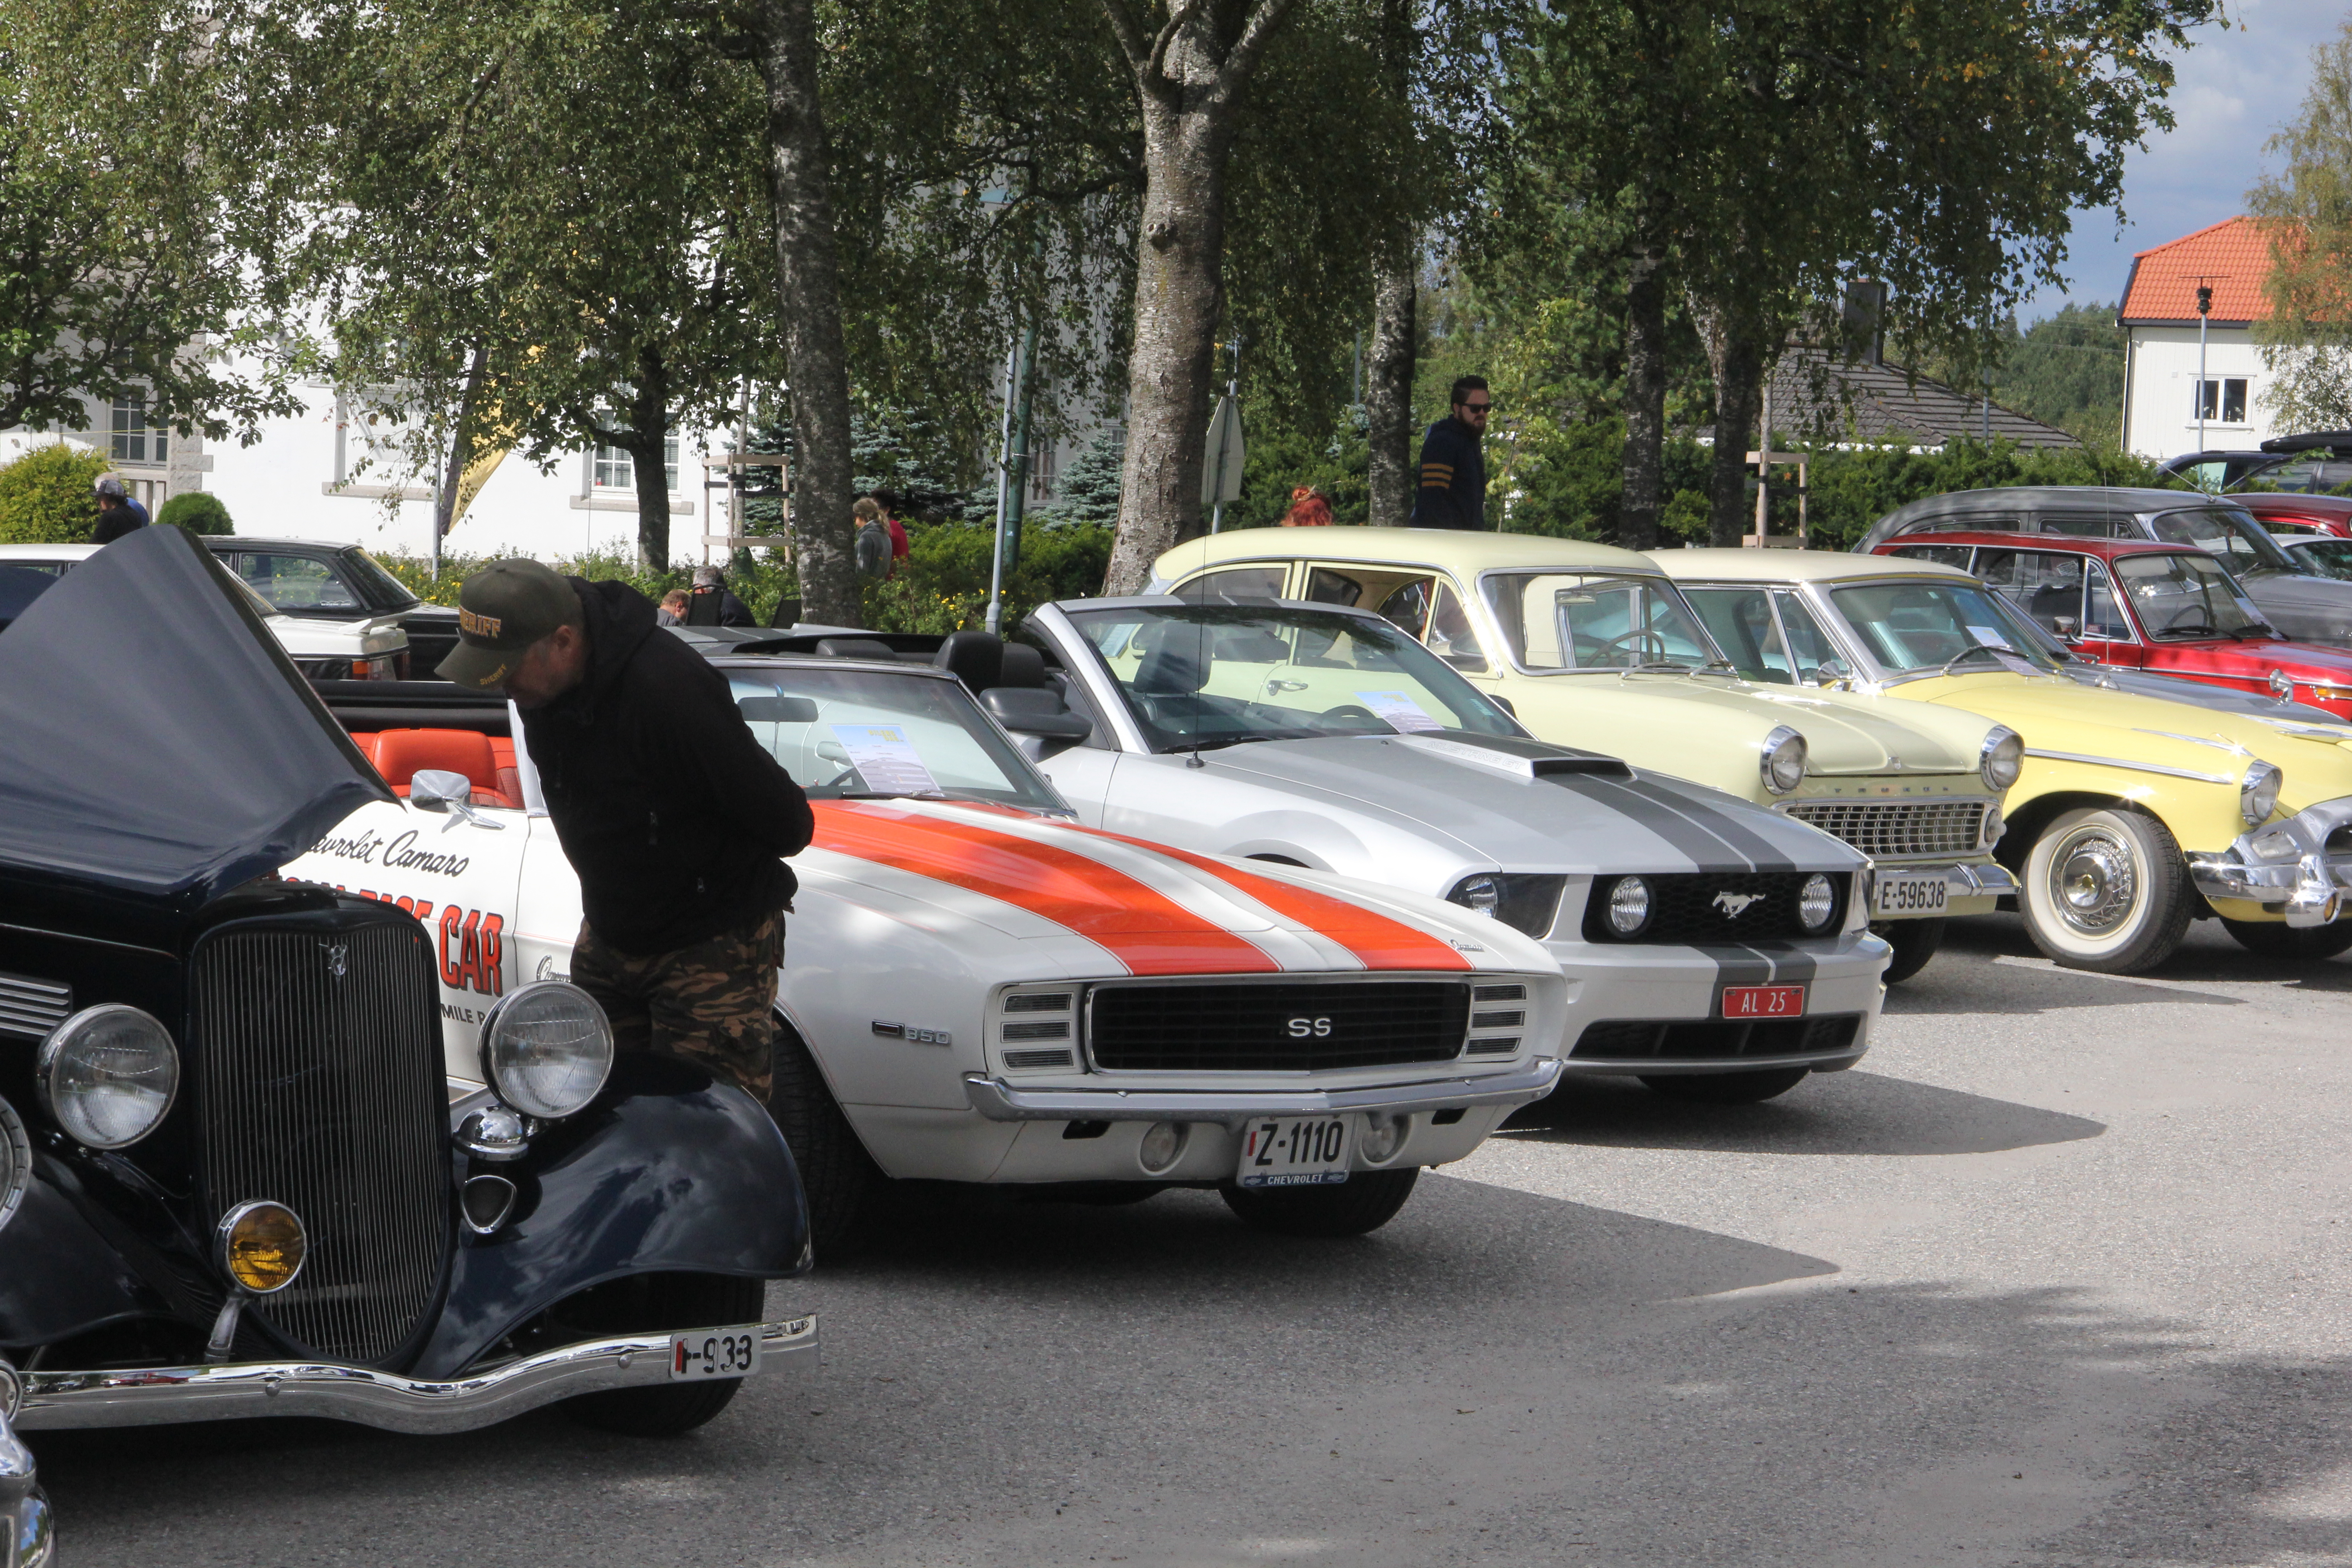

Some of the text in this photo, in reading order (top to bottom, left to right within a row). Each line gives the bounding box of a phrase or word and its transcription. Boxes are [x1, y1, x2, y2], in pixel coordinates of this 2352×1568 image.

[459, 604, 501, 638] ERIFF
[480, 664, 507, 685] SHERIFF
[1427, 741, 1525, 770] MUSTANG GT
[308, 829, 469, 877] evrolet Camaro
[1881, 881, 1945, 910] E-59638
[439, 904, 504, 997] CAR
[440, 1003, 474, 1024] MILE
[1741, 992, 1786, 1013] AL 25
[906, 1026, 951, 1044] 350
[1288, 1018, 1331, 1037] SS
[1255, 1121, 1344, 1166] Z-1110
[1267, 1174, 1323, 1185] CHEVROLET
